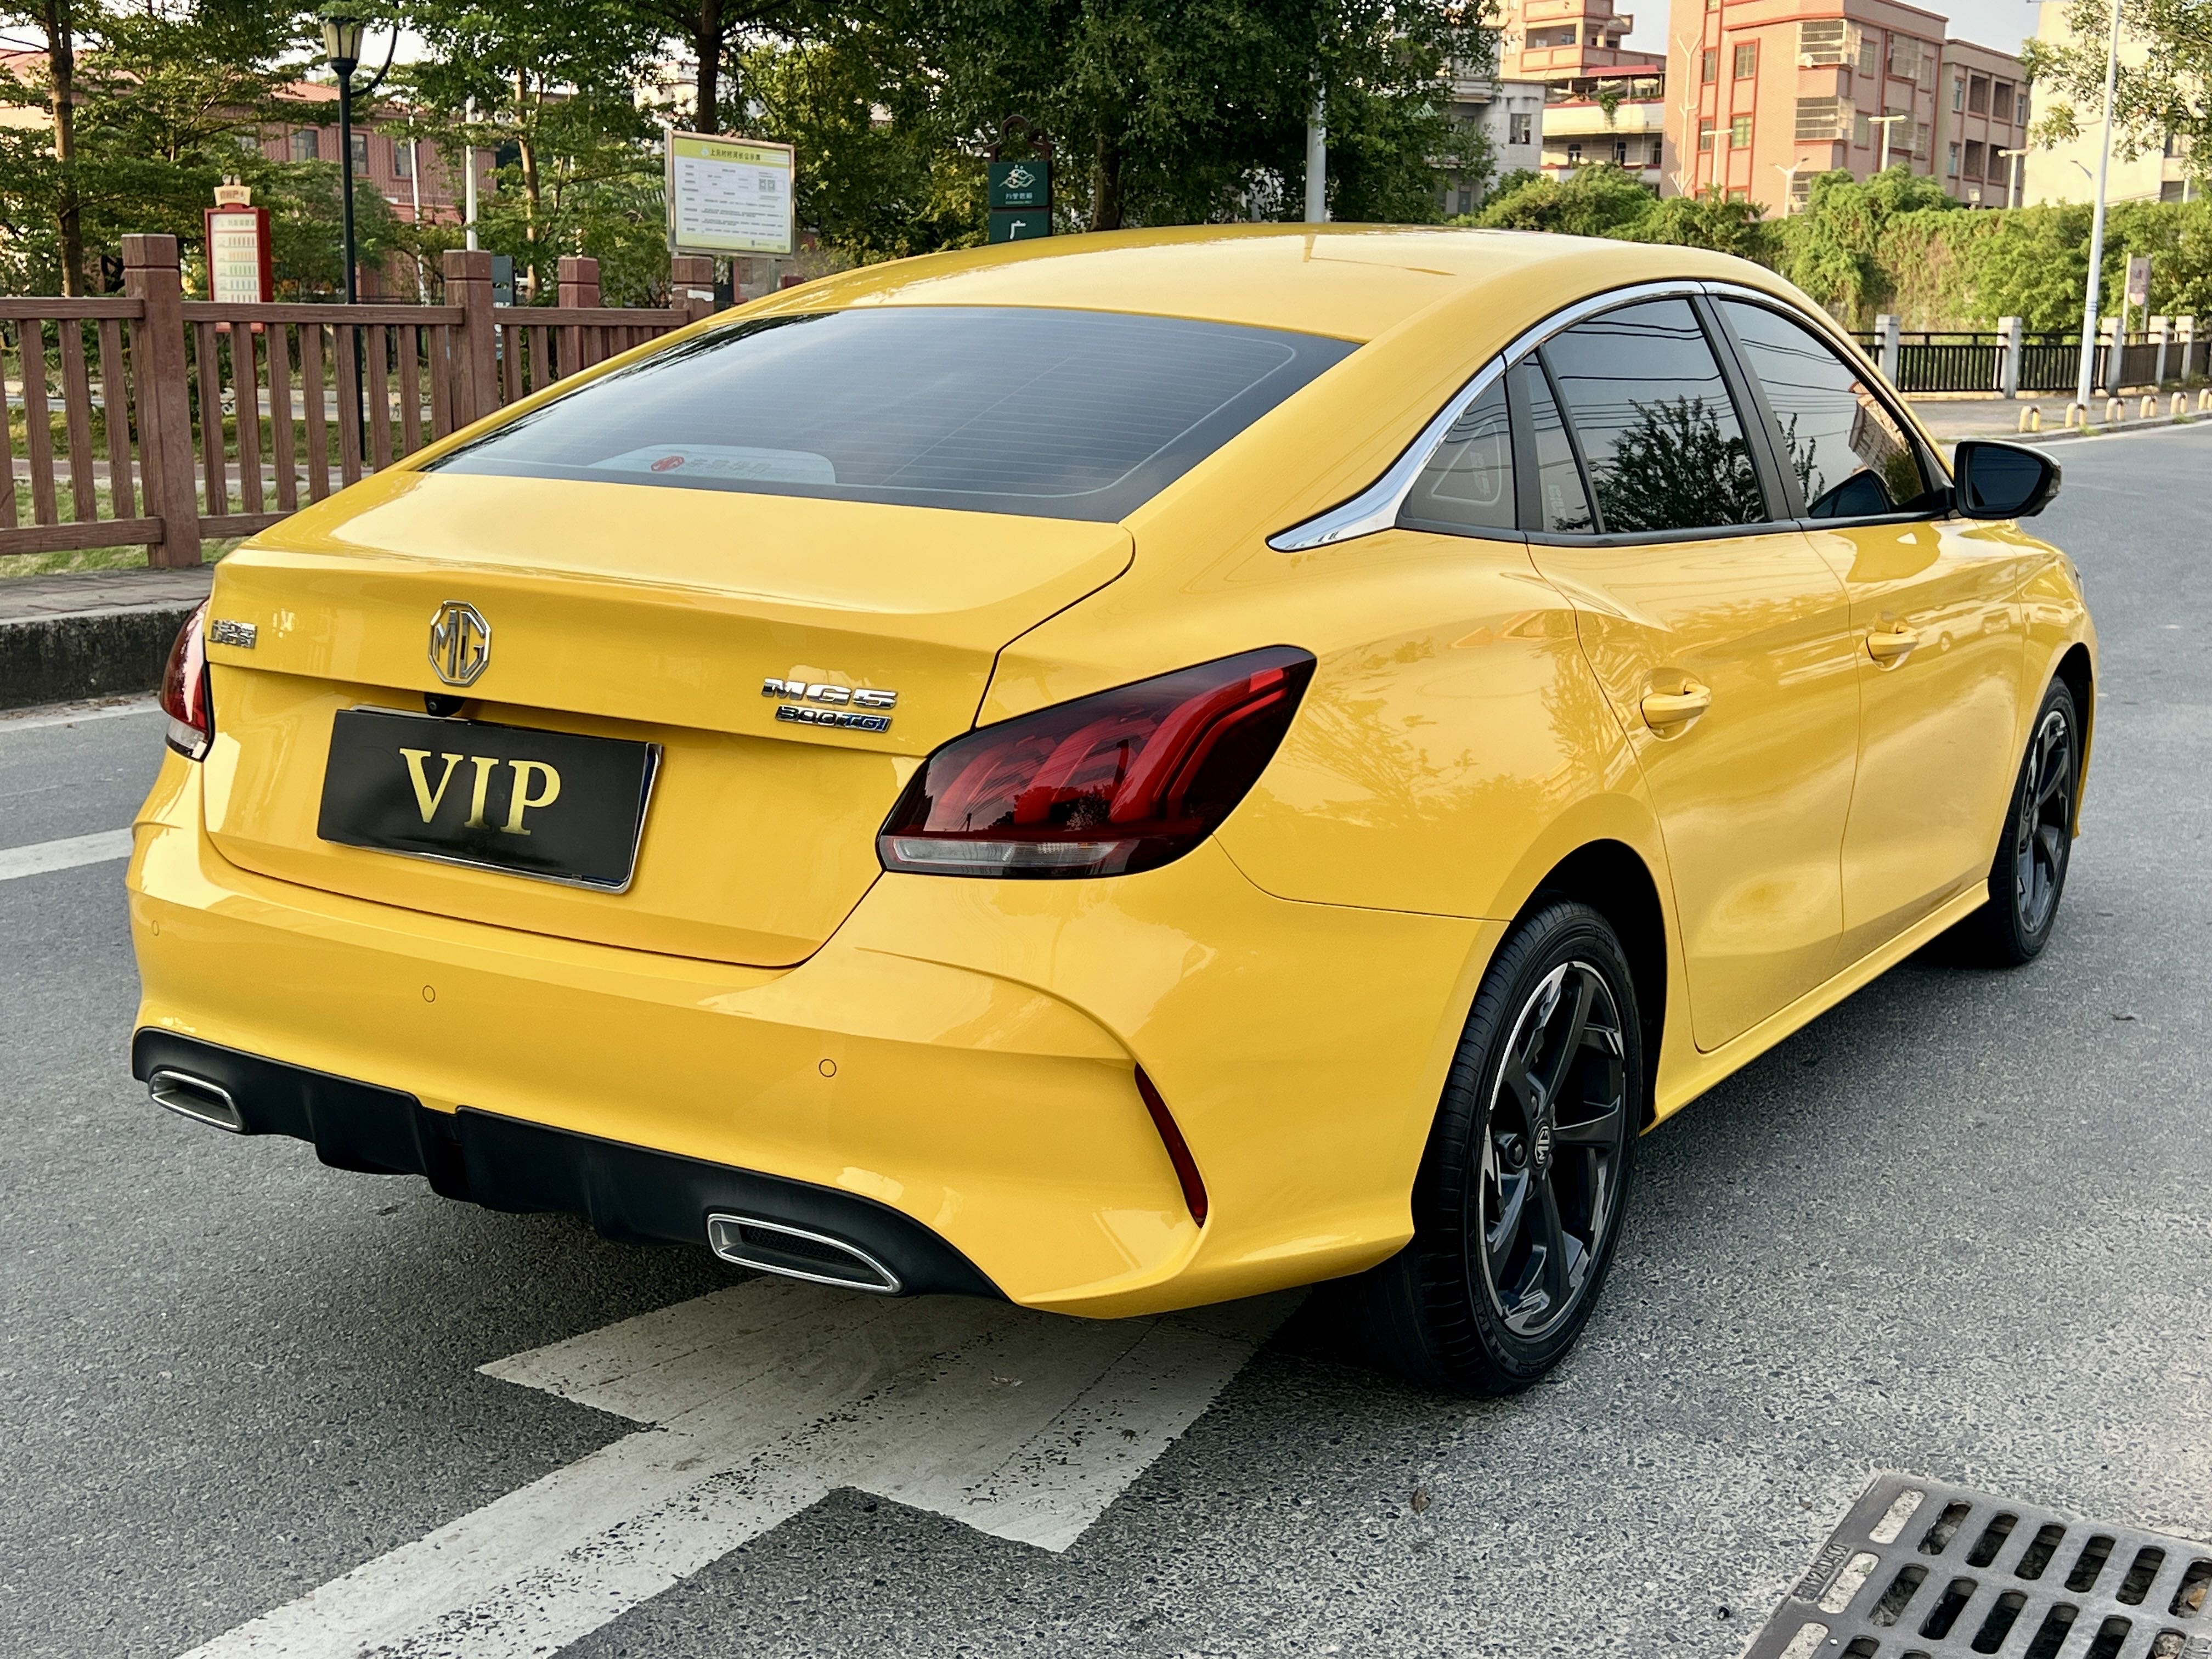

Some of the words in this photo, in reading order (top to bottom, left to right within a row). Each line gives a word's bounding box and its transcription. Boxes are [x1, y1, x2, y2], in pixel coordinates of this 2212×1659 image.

[431, 607, 488, 681] MG
[761, 678, 898, 709] MG5
[399, 748, 561, 836] VIP
[1536, 1128, 1550, 1163] MG
